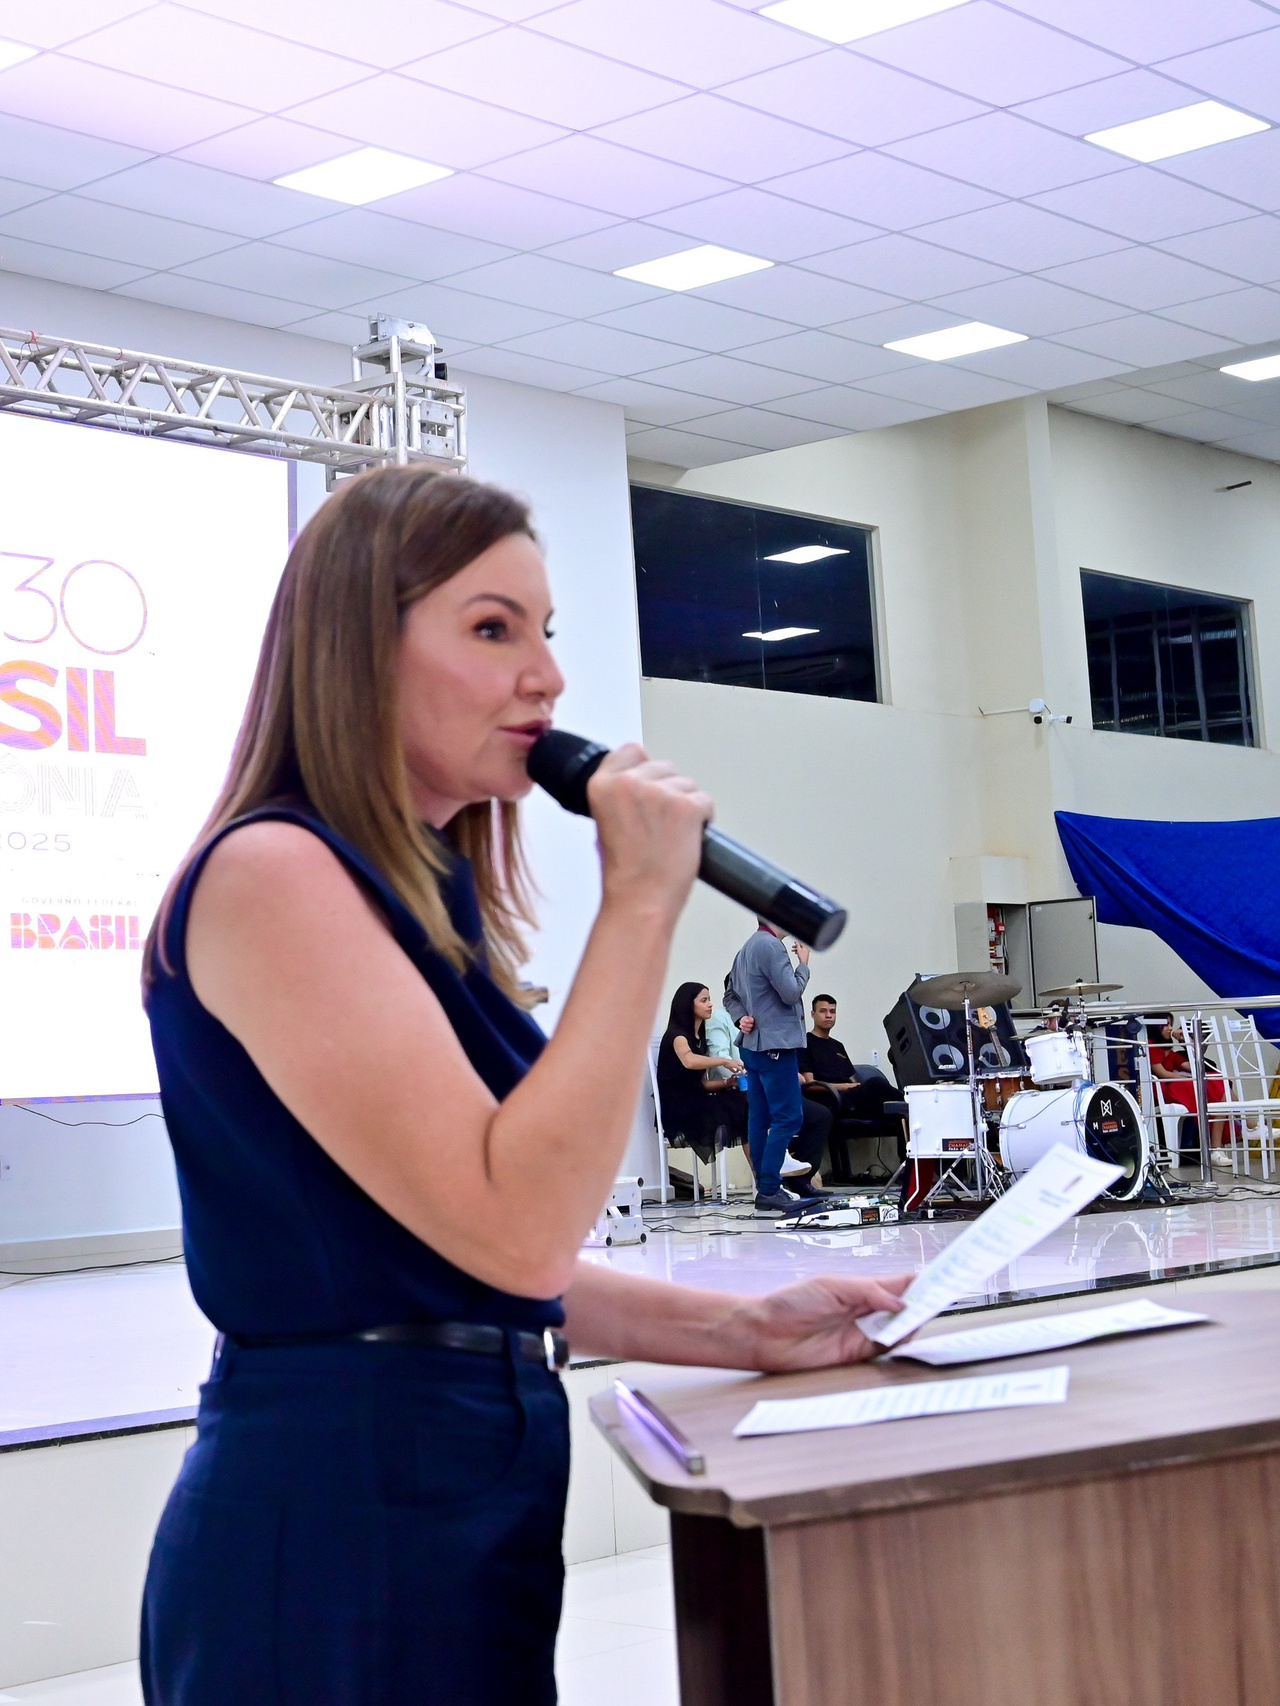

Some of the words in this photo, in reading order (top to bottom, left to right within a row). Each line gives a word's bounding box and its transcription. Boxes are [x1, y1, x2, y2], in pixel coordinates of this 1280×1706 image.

[9, 912, 147, 951] BRASIL
[1092, 1121, 1099, 1131] M
[1120, 1119, 1126, 1128] L
